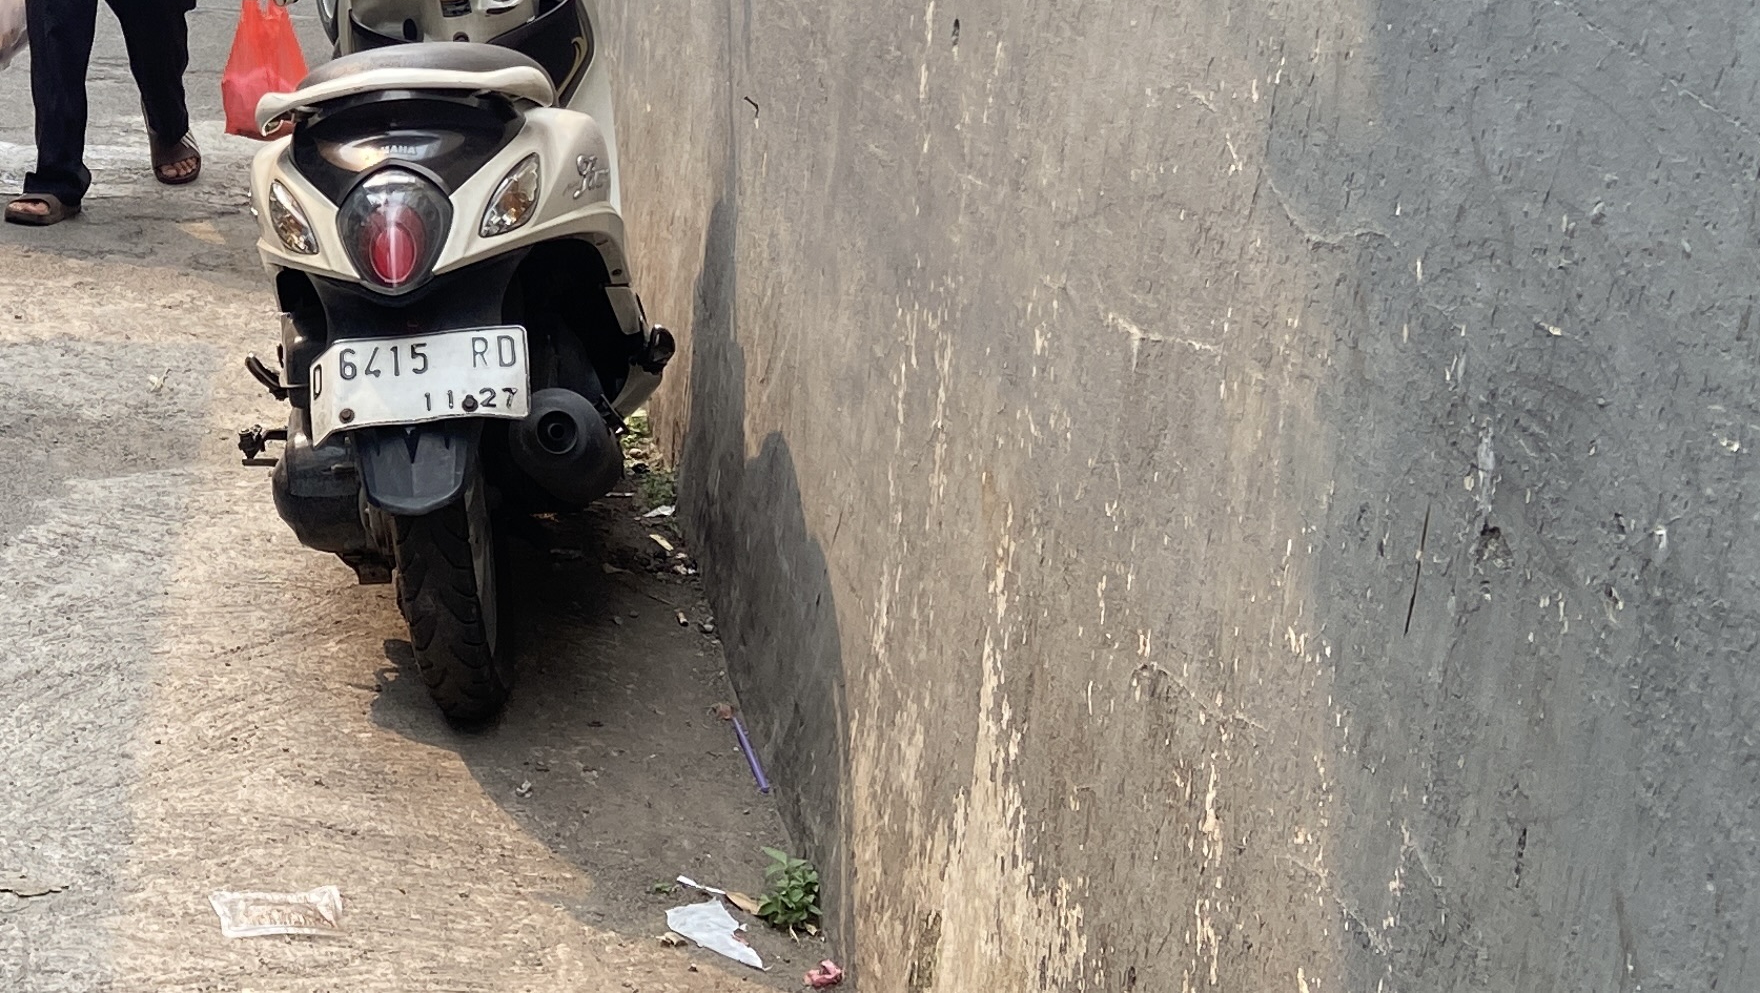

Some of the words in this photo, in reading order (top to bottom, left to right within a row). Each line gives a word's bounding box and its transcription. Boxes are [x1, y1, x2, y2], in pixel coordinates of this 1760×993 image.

[313, 363, 322, 401] D
[340, 343, 429, 380] 6415
[472, 335, 517, 368] RD
